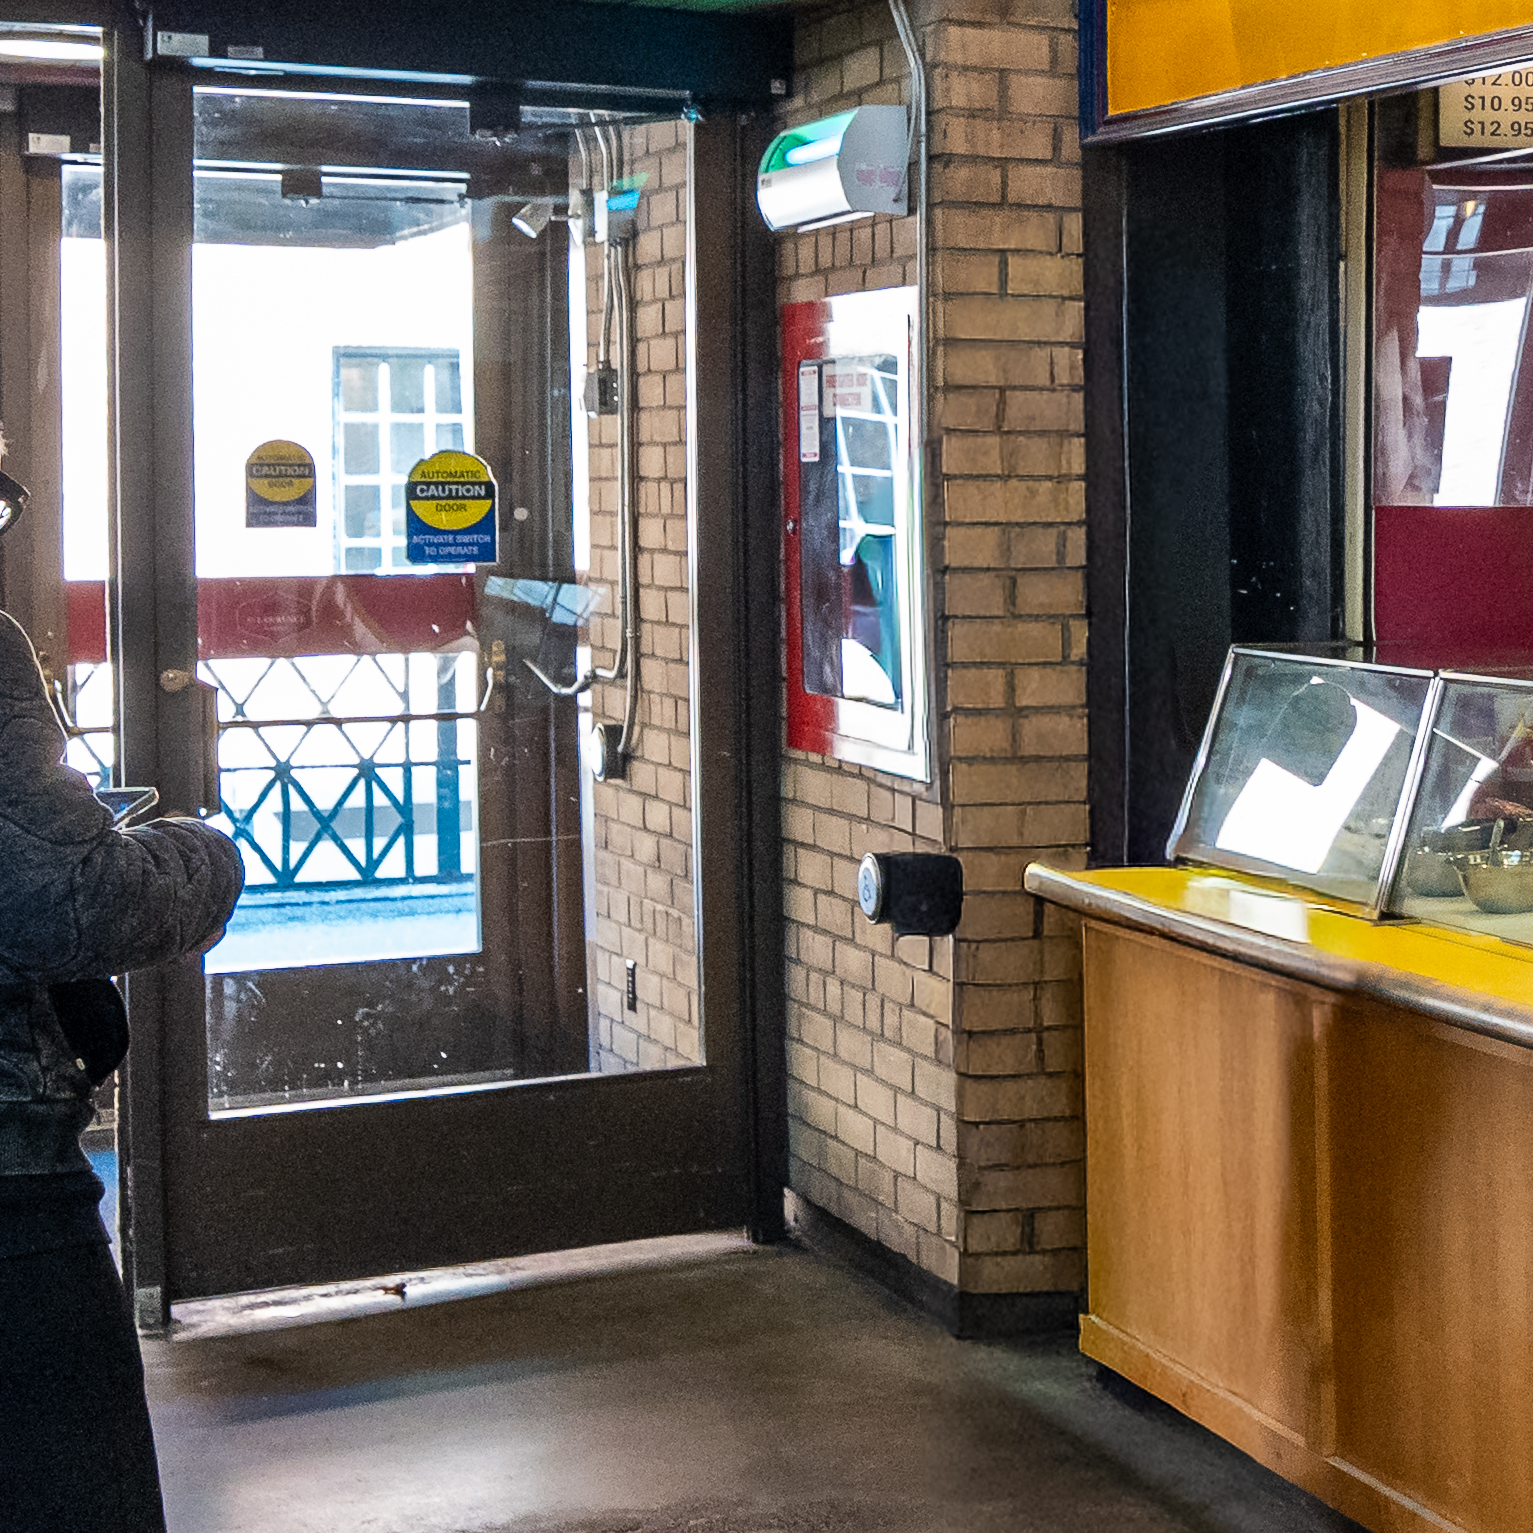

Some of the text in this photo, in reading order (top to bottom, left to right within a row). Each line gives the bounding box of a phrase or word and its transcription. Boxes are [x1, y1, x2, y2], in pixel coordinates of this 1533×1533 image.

[420, 469, 481, 480] AUTOMATIC
[416, 484, 485, 497] CAUTION
[435, 502, 467, 513] DOOR
[411, 534, 492, 544] ACTIVATE SWITCH
